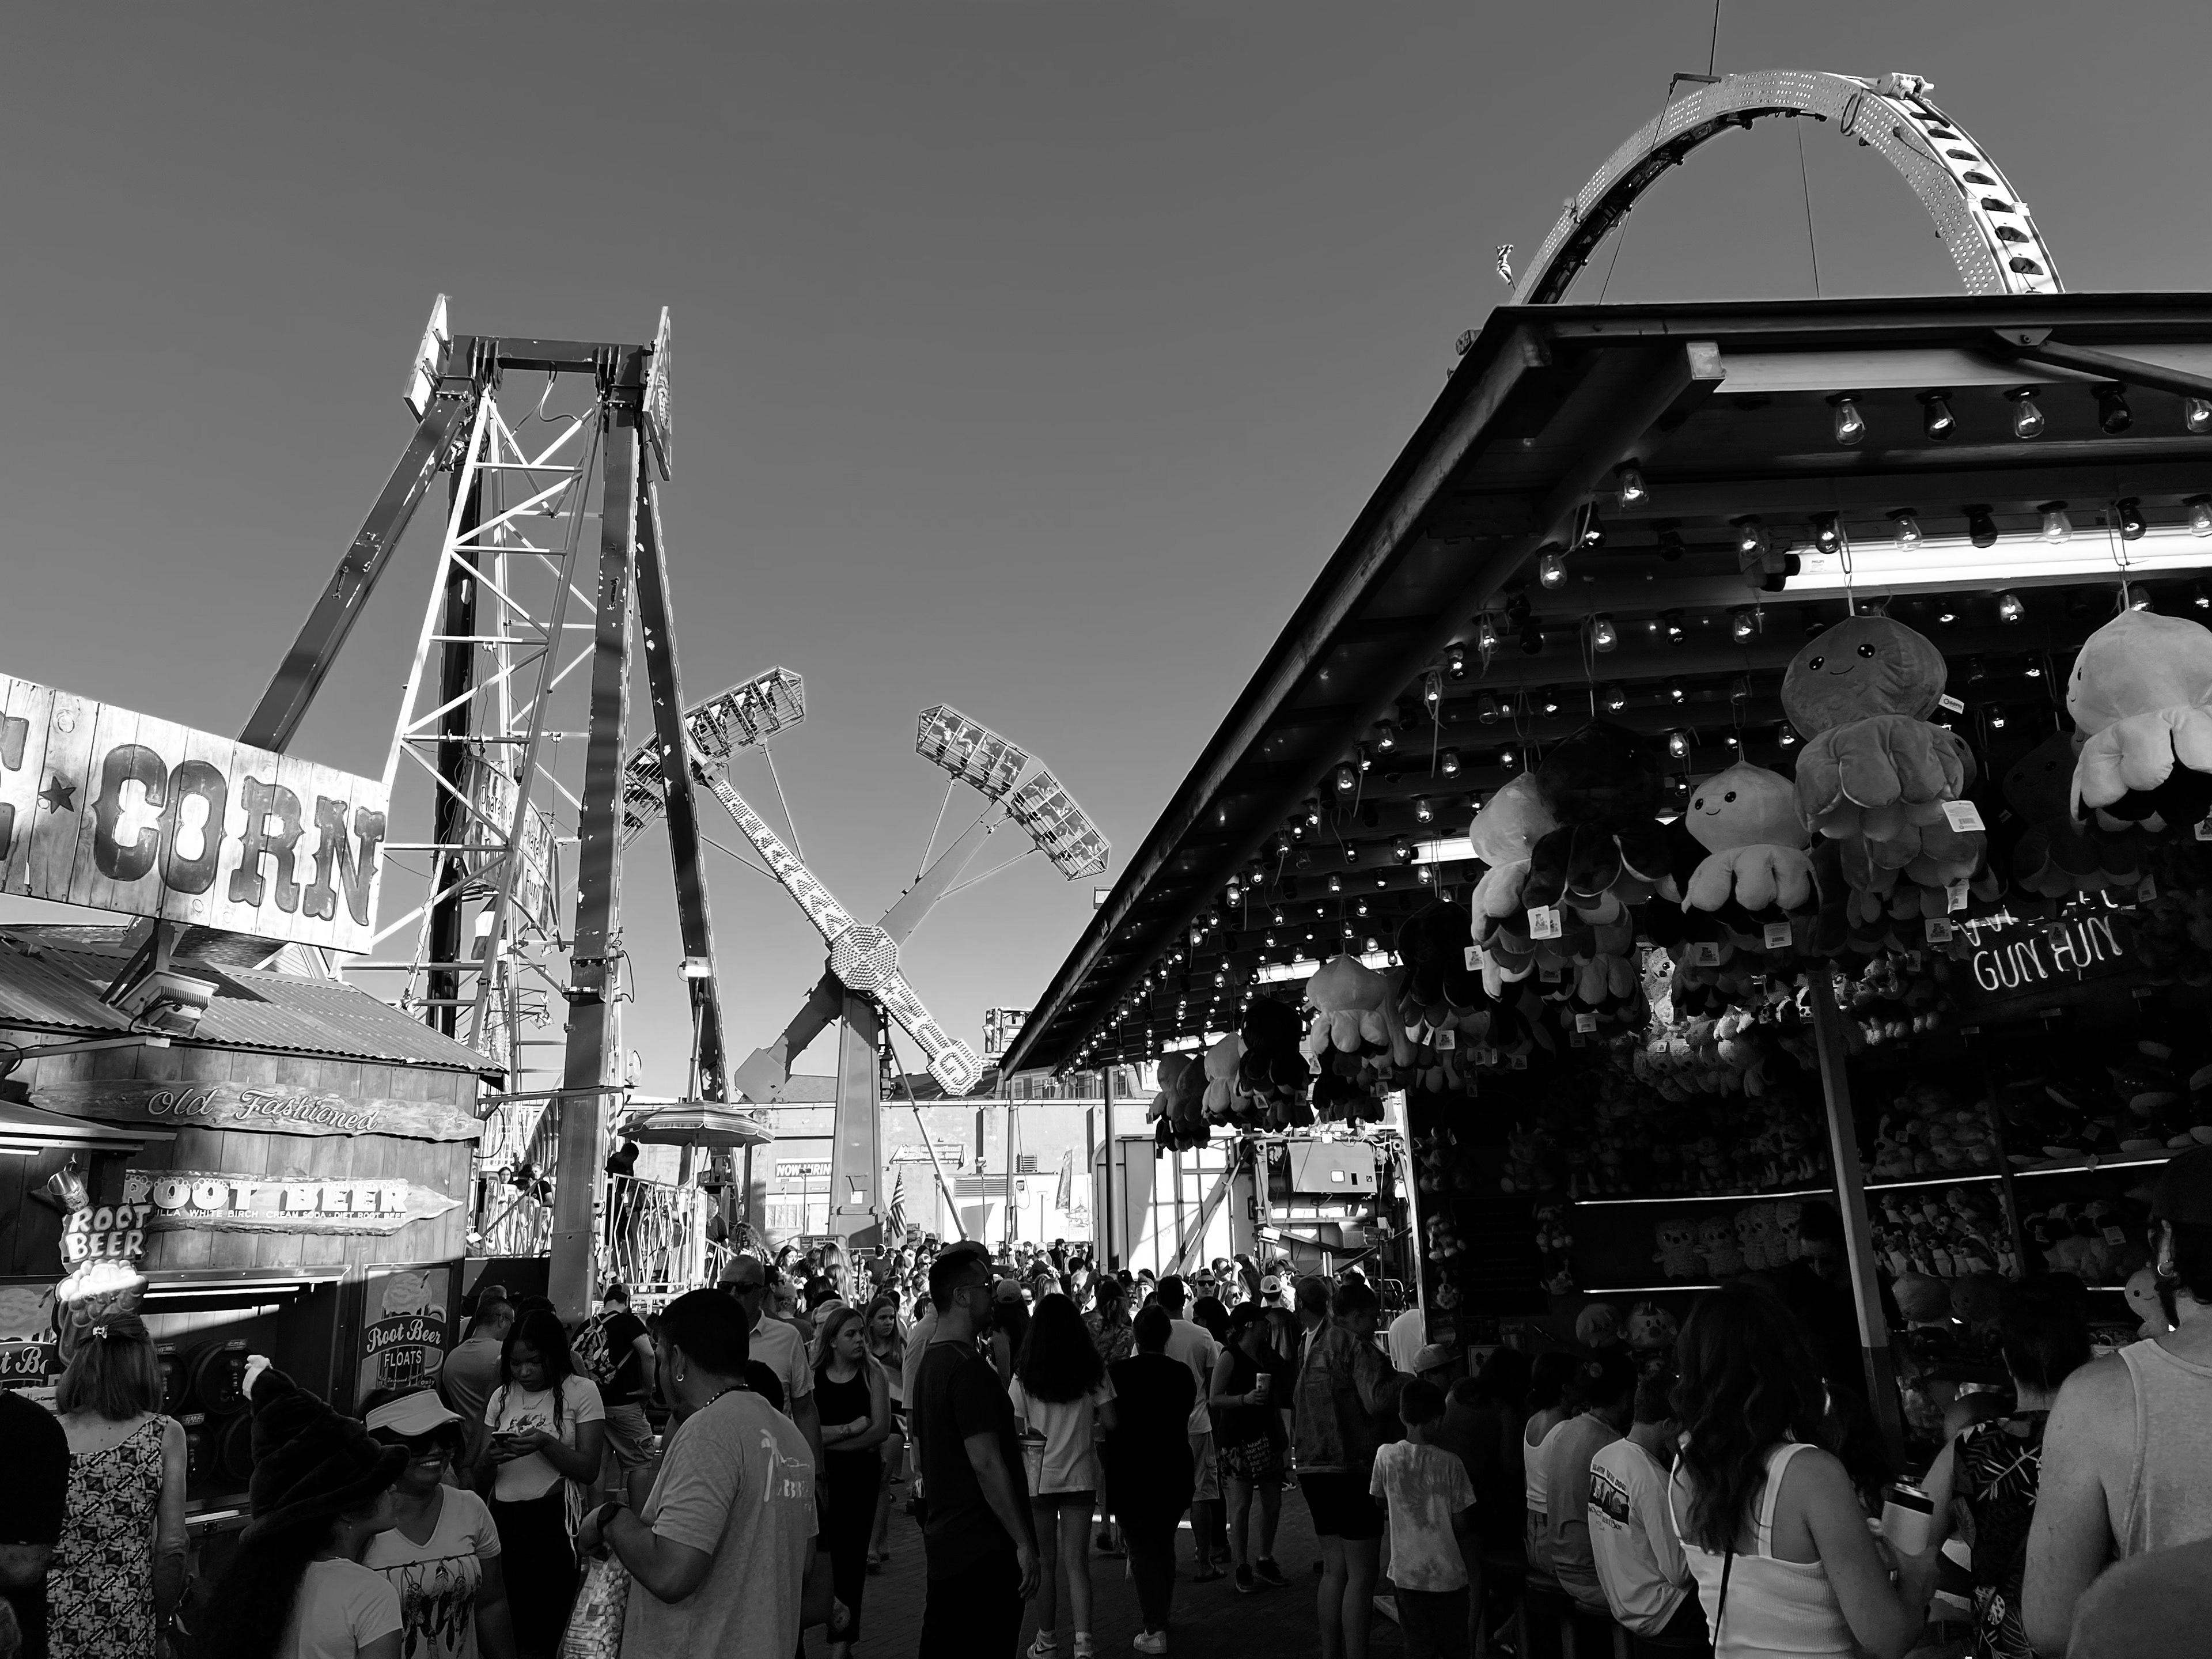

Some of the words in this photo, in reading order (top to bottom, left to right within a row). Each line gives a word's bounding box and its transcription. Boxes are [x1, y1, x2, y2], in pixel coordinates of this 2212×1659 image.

[92, 744, 385, 926] CORN
[1974, 938, 2048, 991] GUN
[148, 1087, 219, 1116] Old
[235, 1089, 381, 1130] Fashioned
[777, 1164, 801, 1176] NOW
[802, 1163, 832, 1176] HIRIN
[123, 1175, 262, 1211] ROOT
[281, 1181, 409, 1213] BEER
[69, 1205, 152, 1233] ROOT
[189, 1210, 223, 1218] WHITE
[228, 1210, 259, 1218] BIRCH
[266, 1211, 299, 1219] CREAM
[334, 1211, 354, 1219] DIET
[66, 1229, 143, 1262] BEER
[366, 1323, 404, 1353] Root
[407, 1319, 441, 1345] Beer
[384, 1350, 422, 1368] FLOATS
